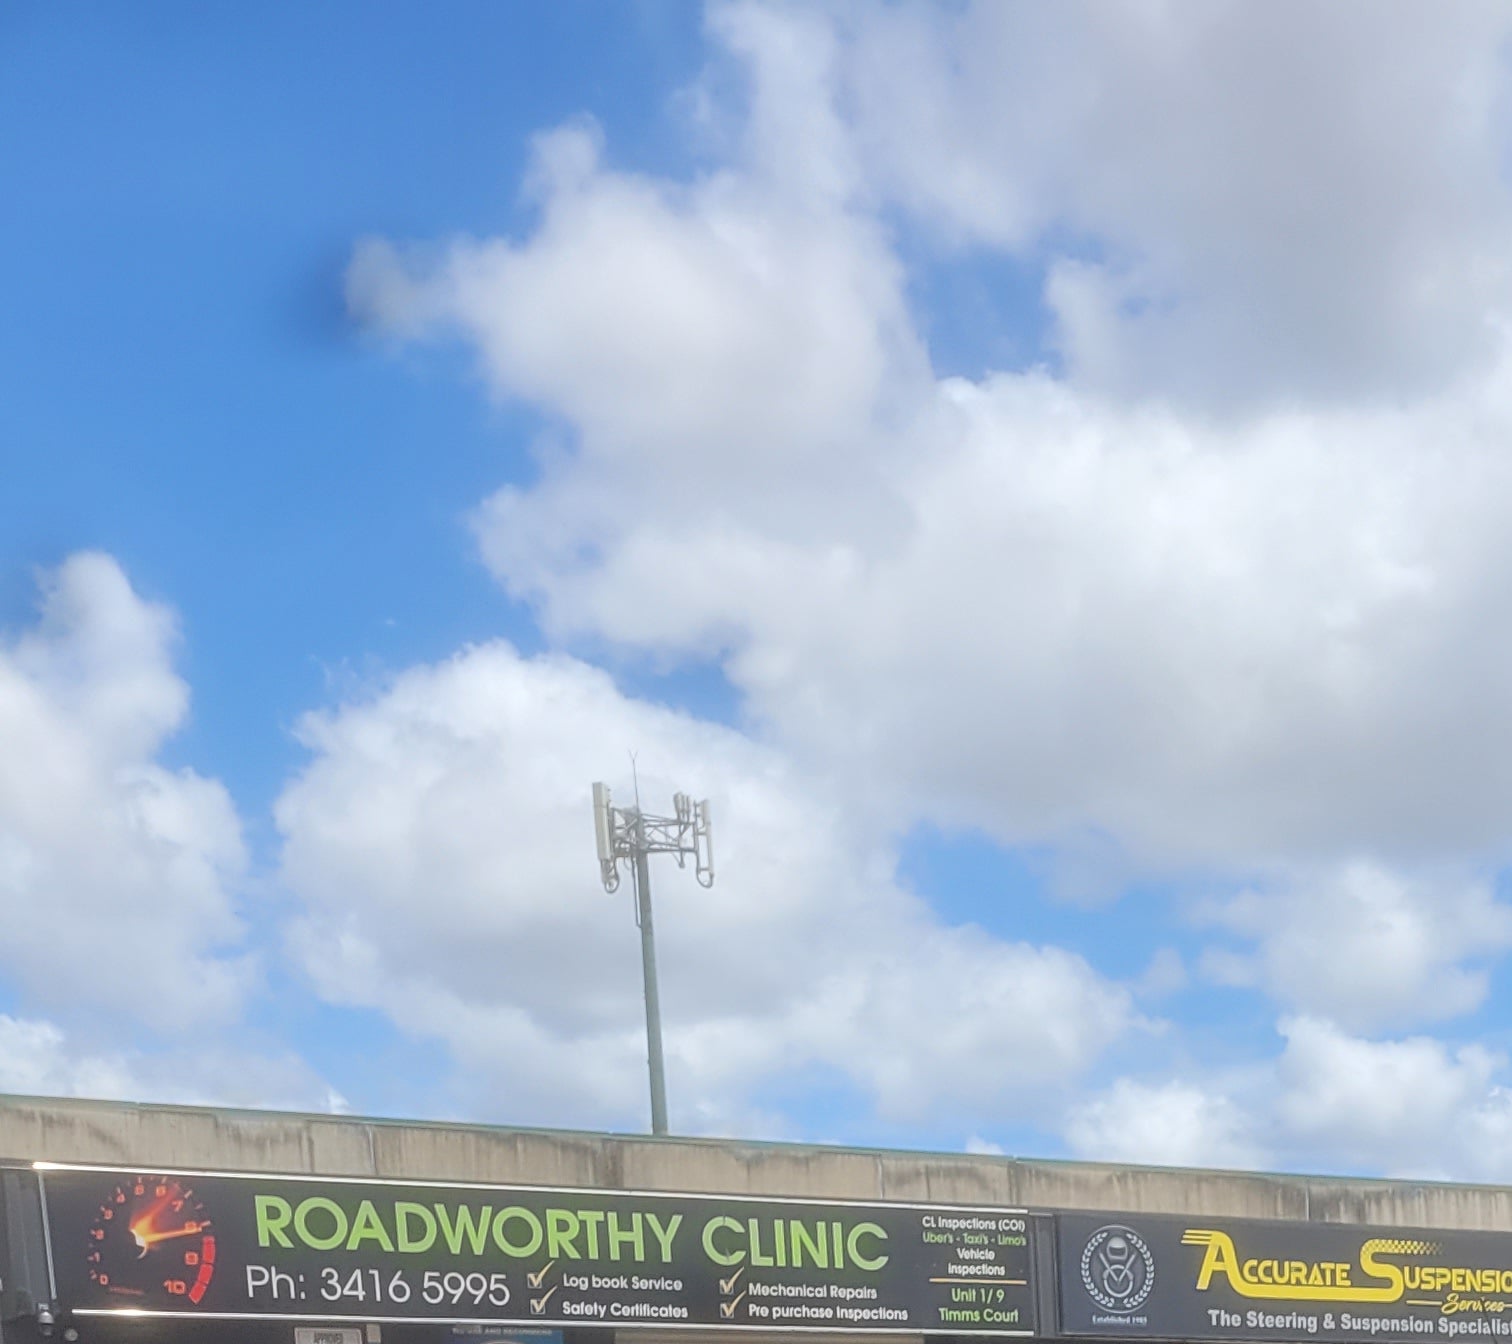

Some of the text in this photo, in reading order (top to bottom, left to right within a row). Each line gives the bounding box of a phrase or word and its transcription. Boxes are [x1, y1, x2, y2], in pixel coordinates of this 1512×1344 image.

[922, 1215, 1026, 1232] CL Inspections (COI)
[254, 1195, 889, 1271] ROADWORTHY CLINIC
[922, 1231, 953, 1244] Uber's
[963, 1232, 989, 1245] Taxi's
[997, 1234, 1027, 1246] Limo's
[956, 1247, 996, 1260] Vehicle
[947, 1262, 1006, 1276] Inspections
[1181, 1229, 1353, 1298] ACCURATE
[163, 1279, 187, 1295] 10
[246, 1265, 511, 1306] Ph: 3416 5995
[562, 1273, 683, 1291] Log book Service
[749, 1282, 877, 1301] Mechanical Repairs
[951, 1288, 977, 1302] Unit
[562, 1301, 689, 1318] Safety Certificates
[749, 1303, 909, 1322] Pre purchase Inspections
[1440, 1292, 1507, 1316] Services
[938, 1307, 1019, 1323] Timms Court
[1208, 1309, 1242, 1328] The
[1246, 1310, 1319, 1334] Steering
[1323, 1313, 1336, 1330] &
[1341, 1313, 1434, 1335] Suspension
